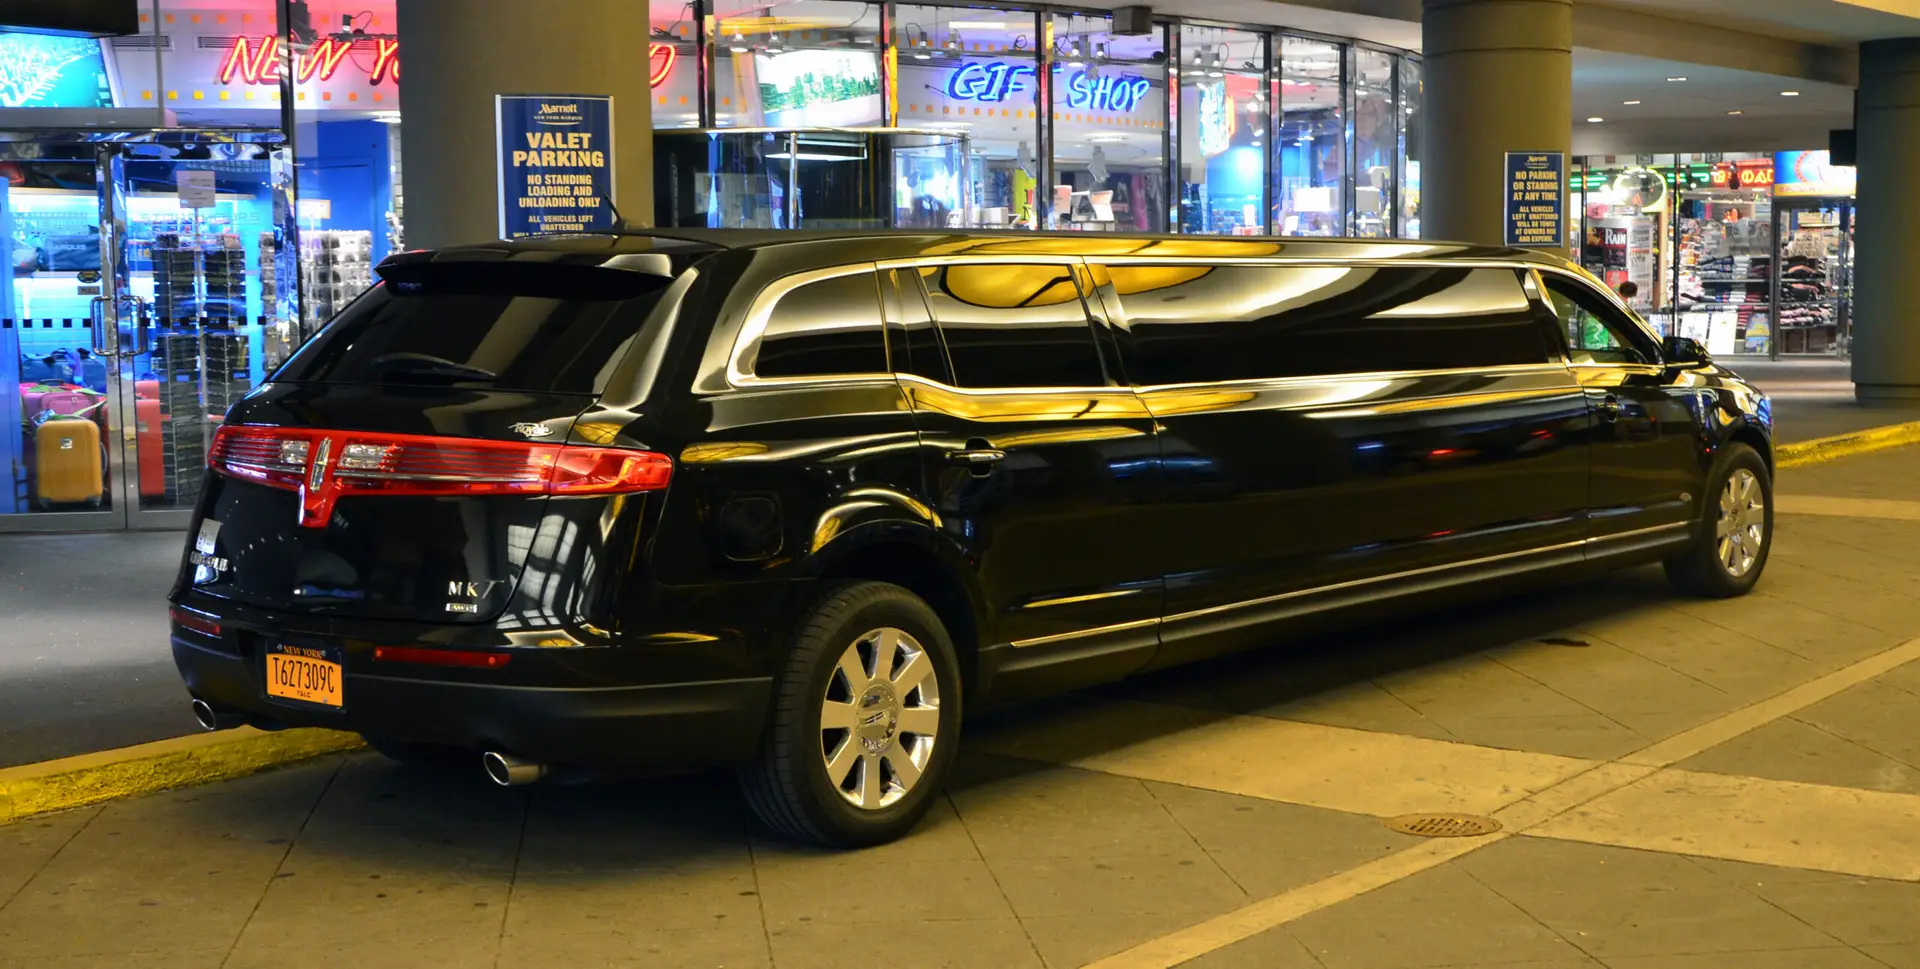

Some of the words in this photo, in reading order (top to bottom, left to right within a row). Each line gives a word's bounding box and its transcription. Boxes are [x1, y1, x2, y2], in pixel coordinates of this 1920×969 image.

[220, 35, 352, 84] NEW
[1067, 70, 1150, 112] SHOP
[538, 103, 577, 114] Marriott
[526, 132, 592, 149] VALET
[513, 151, 604, 167] PARKING
[527, 175, 542, 184] NO
[544, 175, 592, 185] STANDING
[1515, 171, 1527, 180] NO
[1529, 171, 1557, 180] PARKING
[528, 186, 571, 196] LOADING
[573, 187, 592, 196] AND
[1513, 181, 1525, 190] OR
[1526, 181, 1558, 190] STANDING
[1513, 192, 1523, 200] AT
[1525, 192, 1540, 200] ANY
[519, 197, 576, 207] UNLOADING
[578, 198, 600, 207] ONLY
[283, 645, 300, 656] NEW
[302, 648, 322, 659] YORK
[272, 656, 335, 694] T627309C
